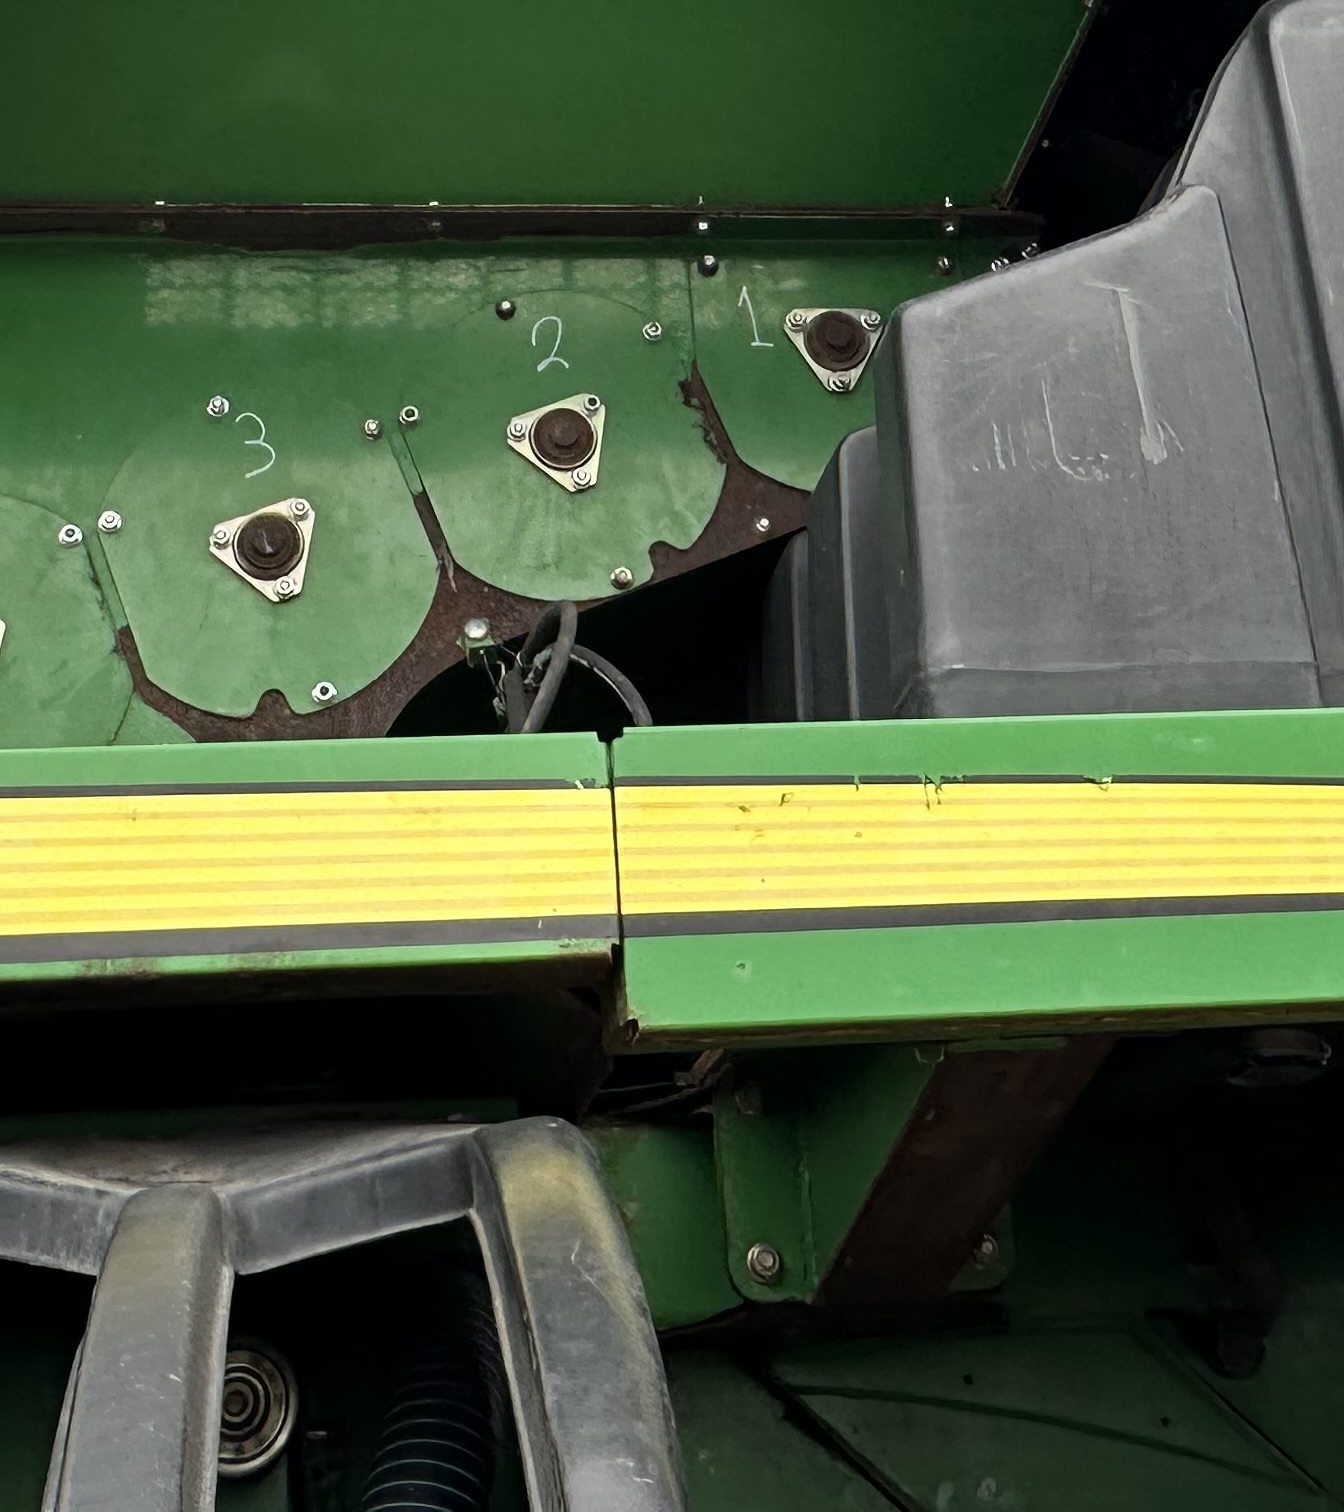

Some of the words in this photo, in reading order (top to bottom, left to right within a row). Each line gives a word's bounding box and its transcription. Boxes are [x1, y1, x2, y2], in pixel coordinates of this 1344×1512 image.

[530, 317, 569, 372] 2
[738, 286, 774, 348] 1
[235, 413, 276, 478] 3
